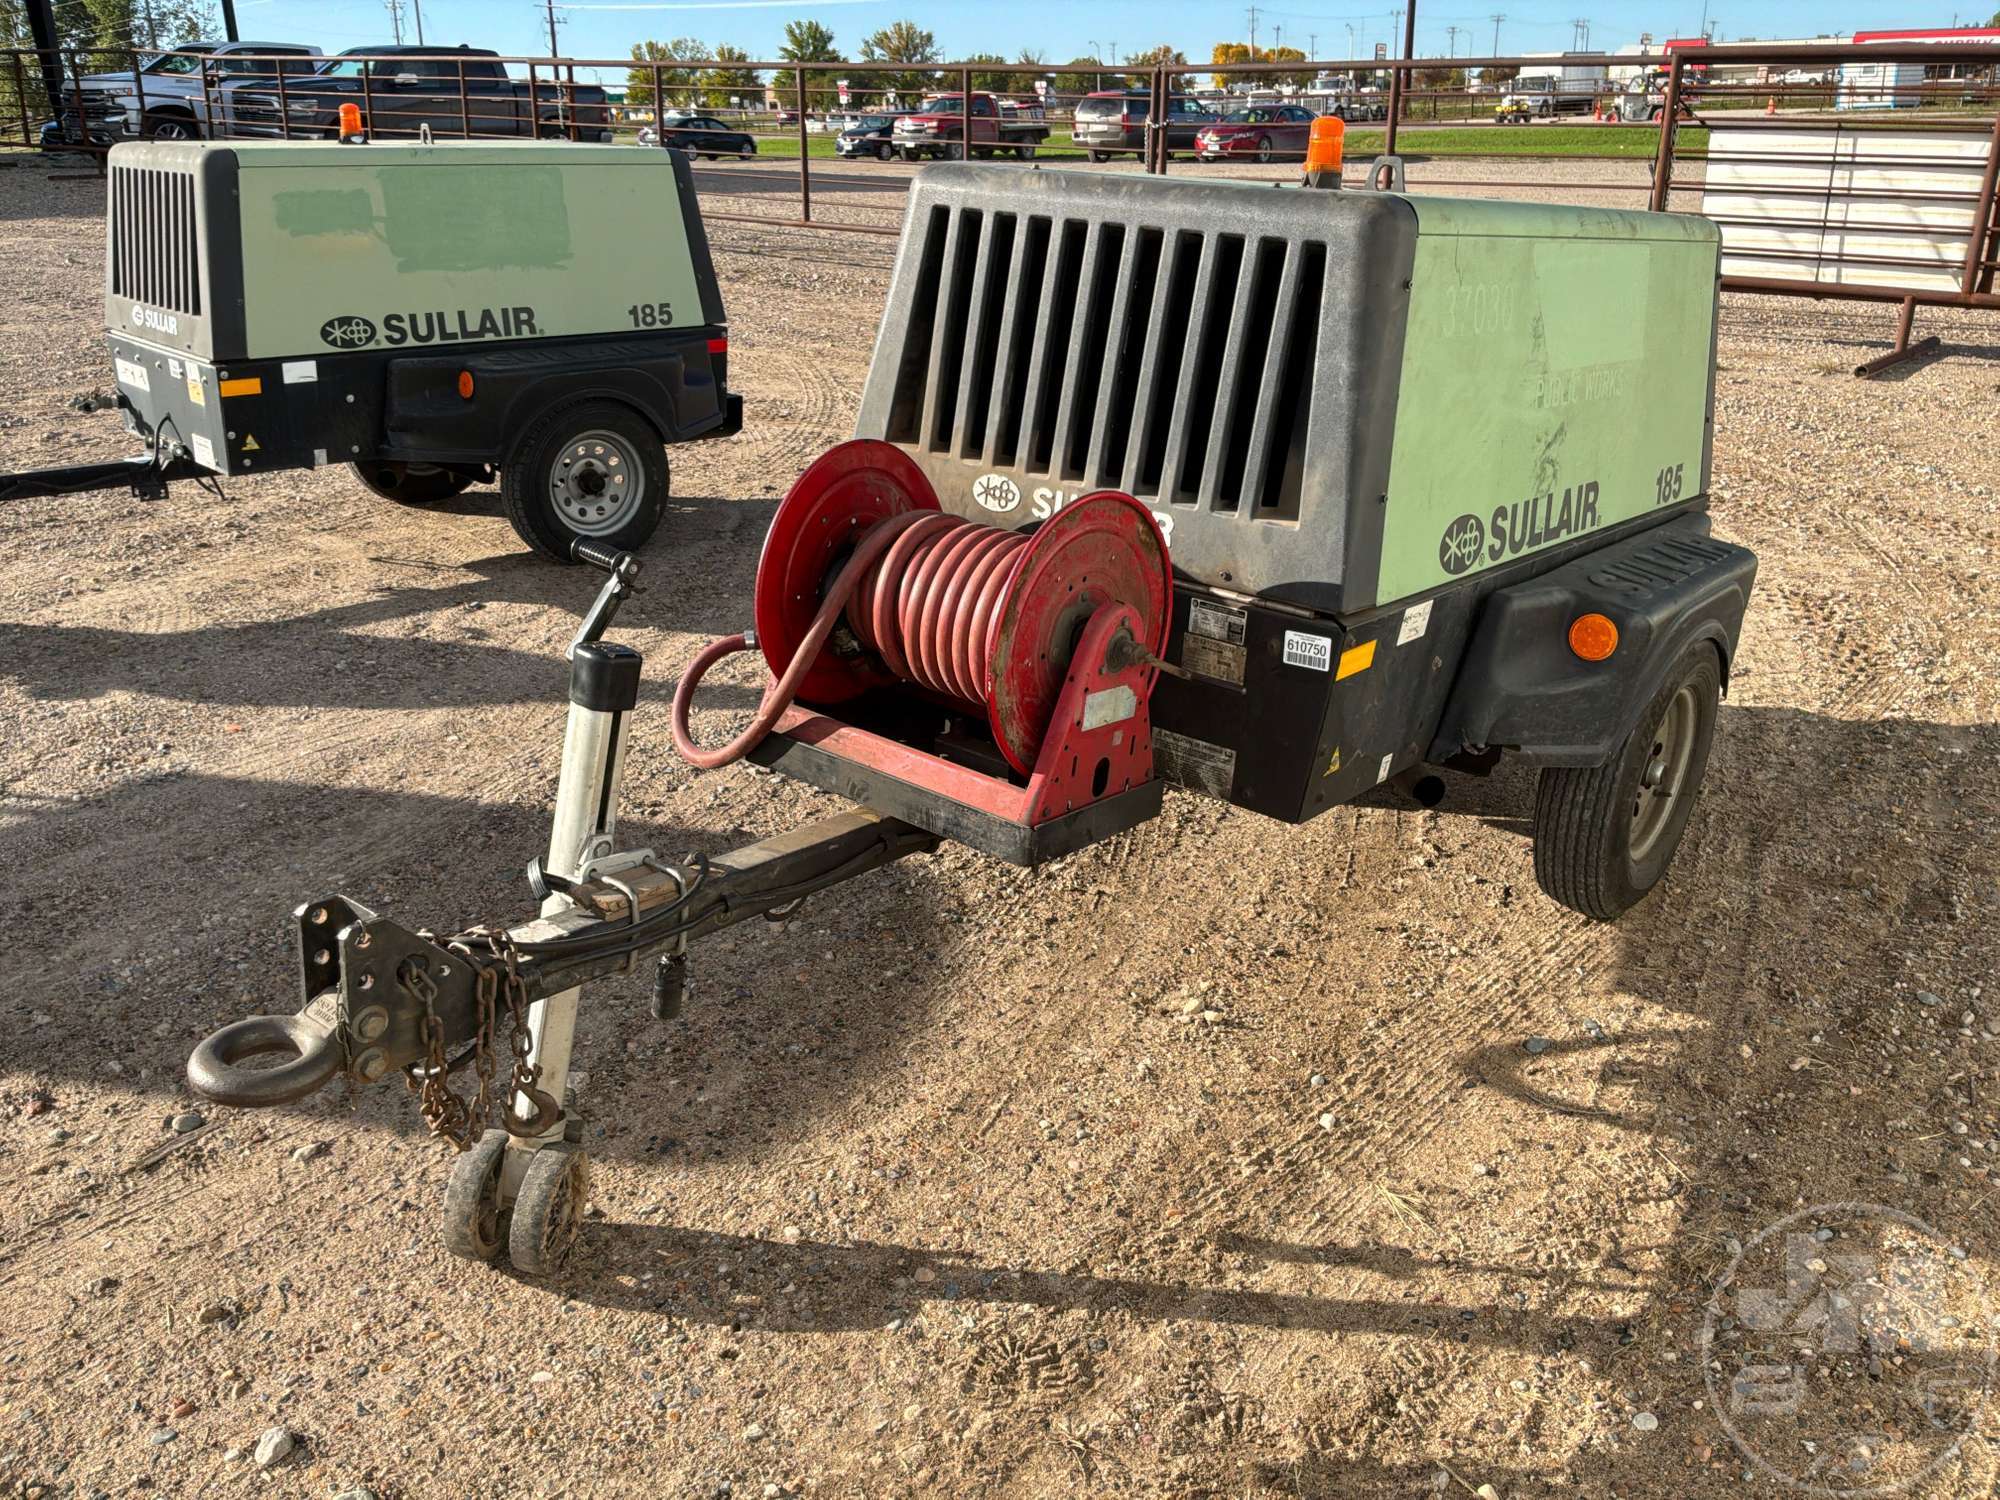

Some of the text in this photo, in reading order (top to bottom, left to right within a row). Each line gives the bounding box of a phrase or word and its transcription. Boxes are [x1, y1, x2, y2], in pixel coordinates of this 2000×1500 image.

[144, 309, 178, 336] SULLAIR
[383, 307, 537, 345] SULLAIR
[628, 303, 673, 328] 185
[1656, 463, 1685, 504] 185
[1488, 481, 1600, 562] SULLAIR
[1287, 638, 1327, 658] 610750
